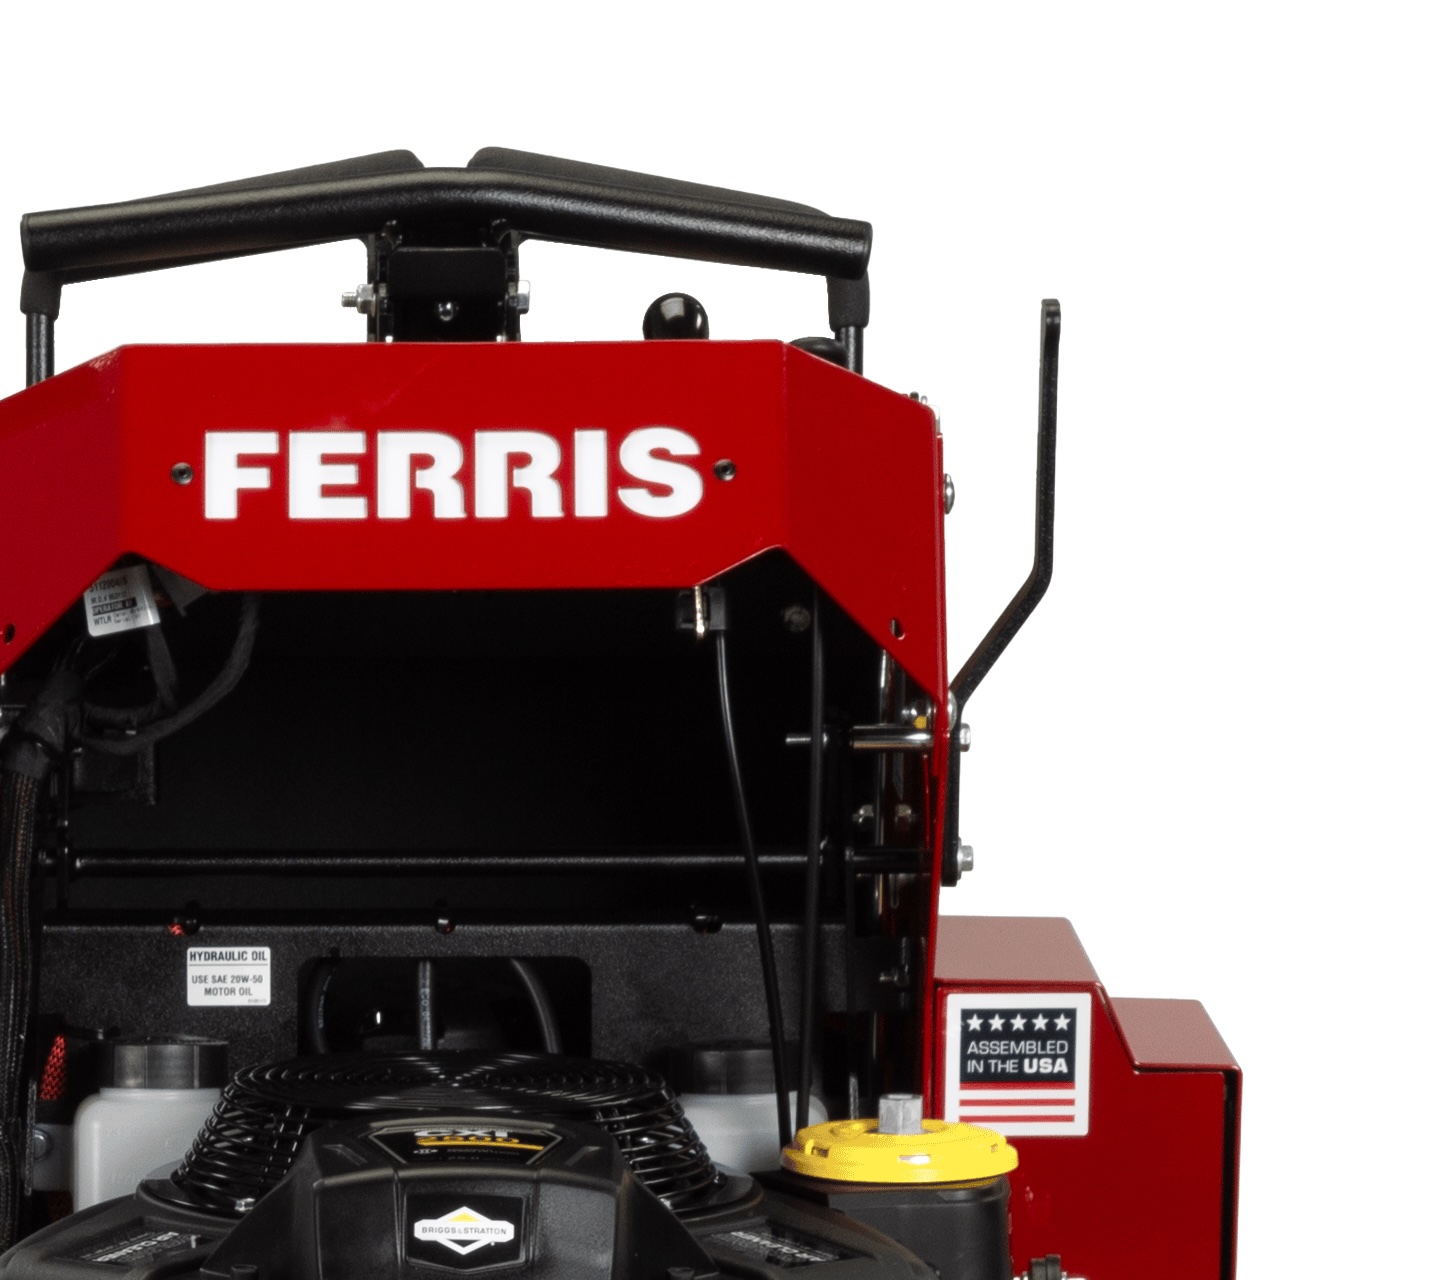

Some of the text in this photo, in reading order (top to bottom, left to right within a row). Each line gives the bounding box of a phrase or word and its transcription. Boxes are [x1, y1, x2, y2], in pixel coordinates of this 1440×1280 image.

[202, 426, 705, 521] FERRIS
[189, 949, 268, 962] HYDRAULIC OIL
[191, 974, 264, 984] USE SAE 20W-50
[204, 986, 254, 997] MOTOR OIL
[967, 1040, 1069, 1055] ASSEMBLED
[967, 1057, 1069, 1074] IN THE USA
